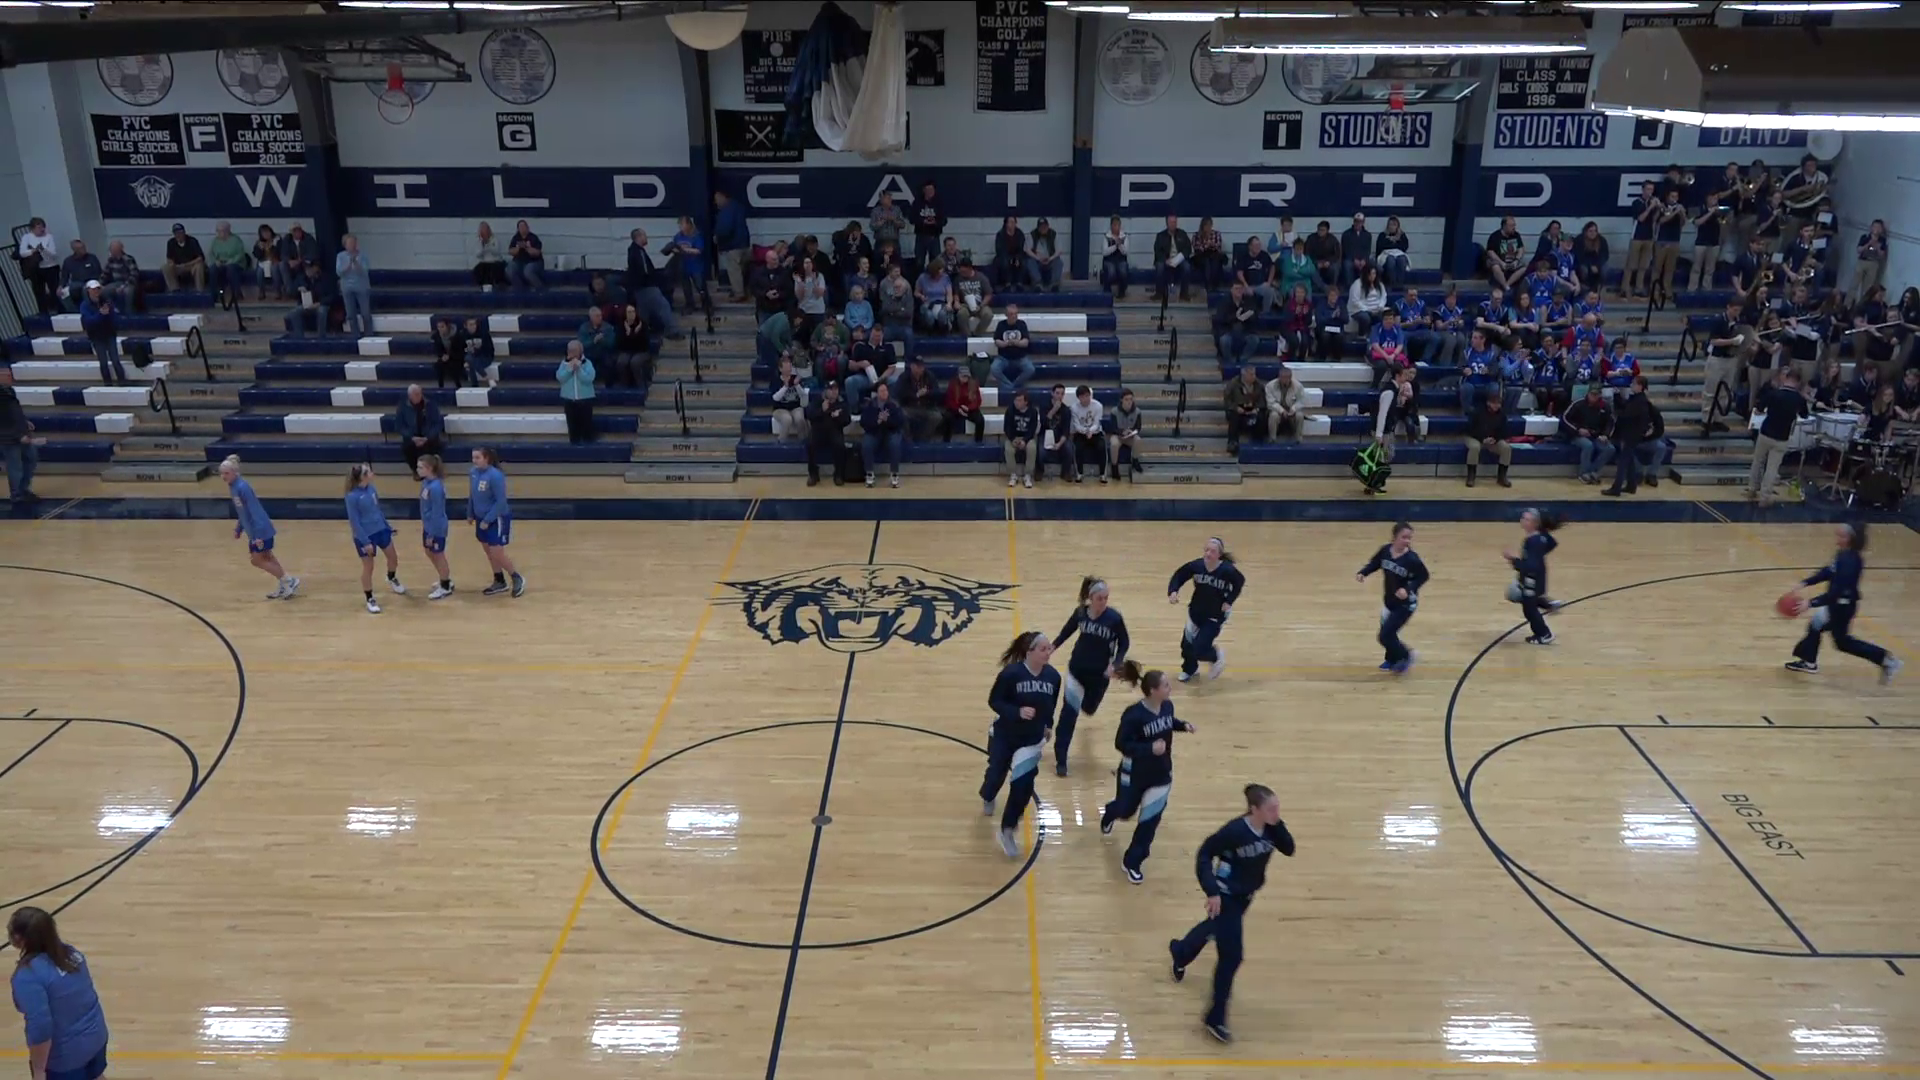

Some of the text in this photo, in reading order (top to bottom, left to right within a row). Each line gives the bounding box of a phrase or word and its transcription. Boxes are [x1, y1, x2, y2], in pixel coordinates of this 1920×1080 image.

[995, 1, 1029, 16] PVC
[980, 16, 1045, 28] CHAMPIONS
[997, 28, 1029, 41] GOLF
[1516, 70, 1572, 82] CLASS A
[1526, 94, 1557, 107] 1996
[121, 116, 152, 130] PVC
[184, 115, 219, 123] SECTION
[250, 115, 283, 128] PVC
[498, 114, 533, 122] SECTION
[1265, 113, 1301, 121] SECTION
[107, 129, 171, 142] CHAMPIONS
[237, 129, 303, 142] CHAMPIONS
[501, 123, 533, 149] G
[1323, 115, 1428, 146] STUDENTS
[1499, 116, 1604, 146] STUDENTS
[1640, 120, 1667, 148] J
[191, 125, 217, 150] F
[101, 140, 180, 154] GIRLS SOCCER
[232, 141, 266, 153] GIRLS
[129, 154, 156, 166] 2011
[259, 153, 286, 165] 2012
[1169, 444, 1187, 452] ROW
[1721, 794, 1805, 860] BIG EAST
